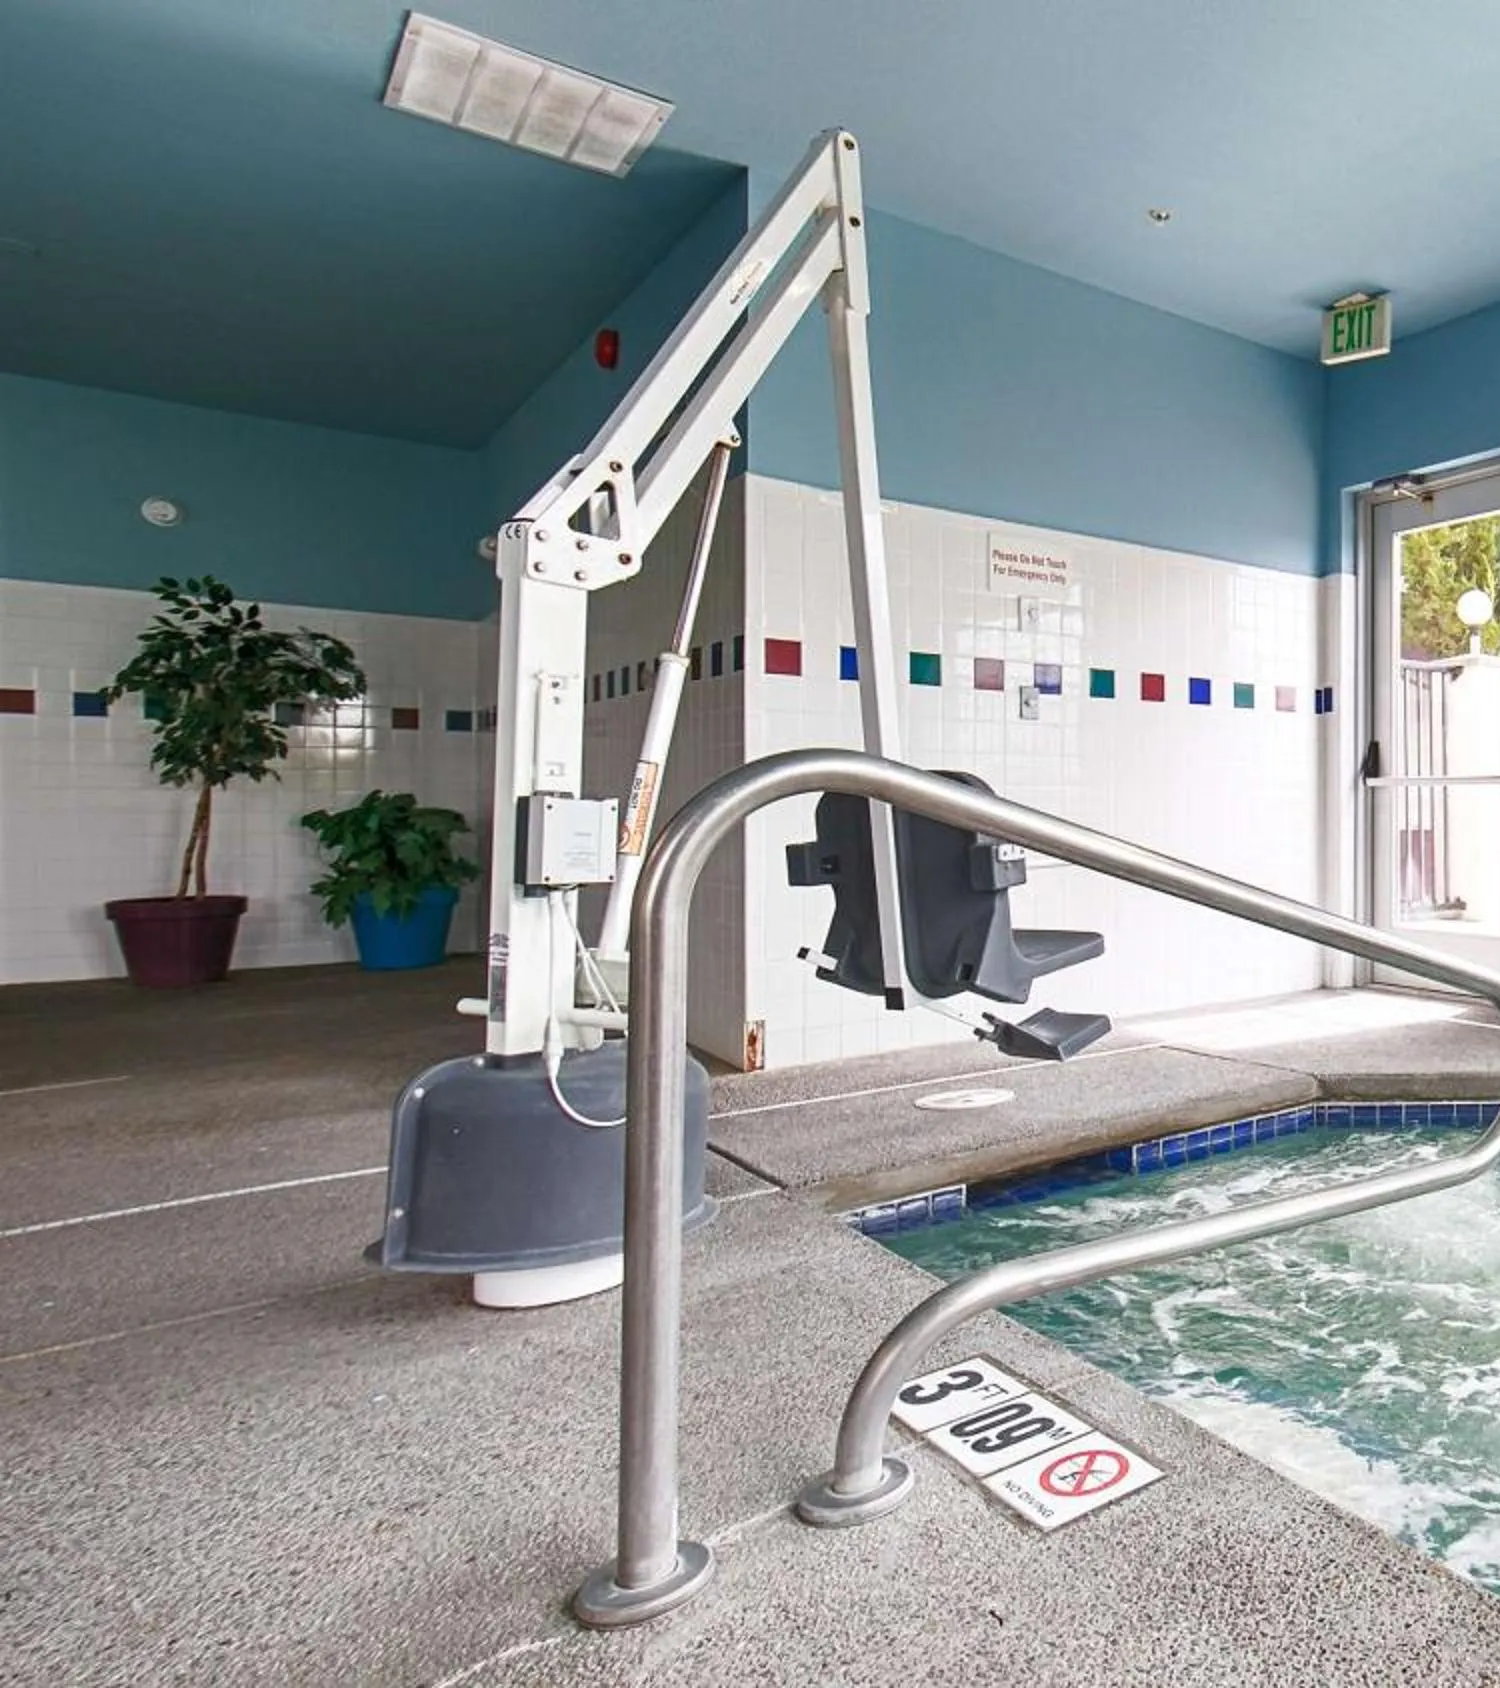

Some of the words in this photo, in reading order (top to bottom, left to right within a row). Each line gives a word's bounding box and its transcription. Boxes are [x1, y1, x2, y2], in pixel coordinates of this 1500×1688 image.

[1333, 303, 1376, 353] EXIT
[992, 550, 1018, 562] Please
[1020, 553, 1030, 564] Do
[1032, 555, 1044, 566] Not
[1046, 557, 1066, 569] Touch
[993, 563, 1006, 574] For
[1008, 566, 1048, 583] Emergency
[1050, 573, 1066, 585] Only
[899, 1370, 984, 1405] 3
[971, 1383, 1008, 1400] FT
[1004, 1480, 1021, 1493] NO
[1018, 1491, 1055, 1519] DIVING
